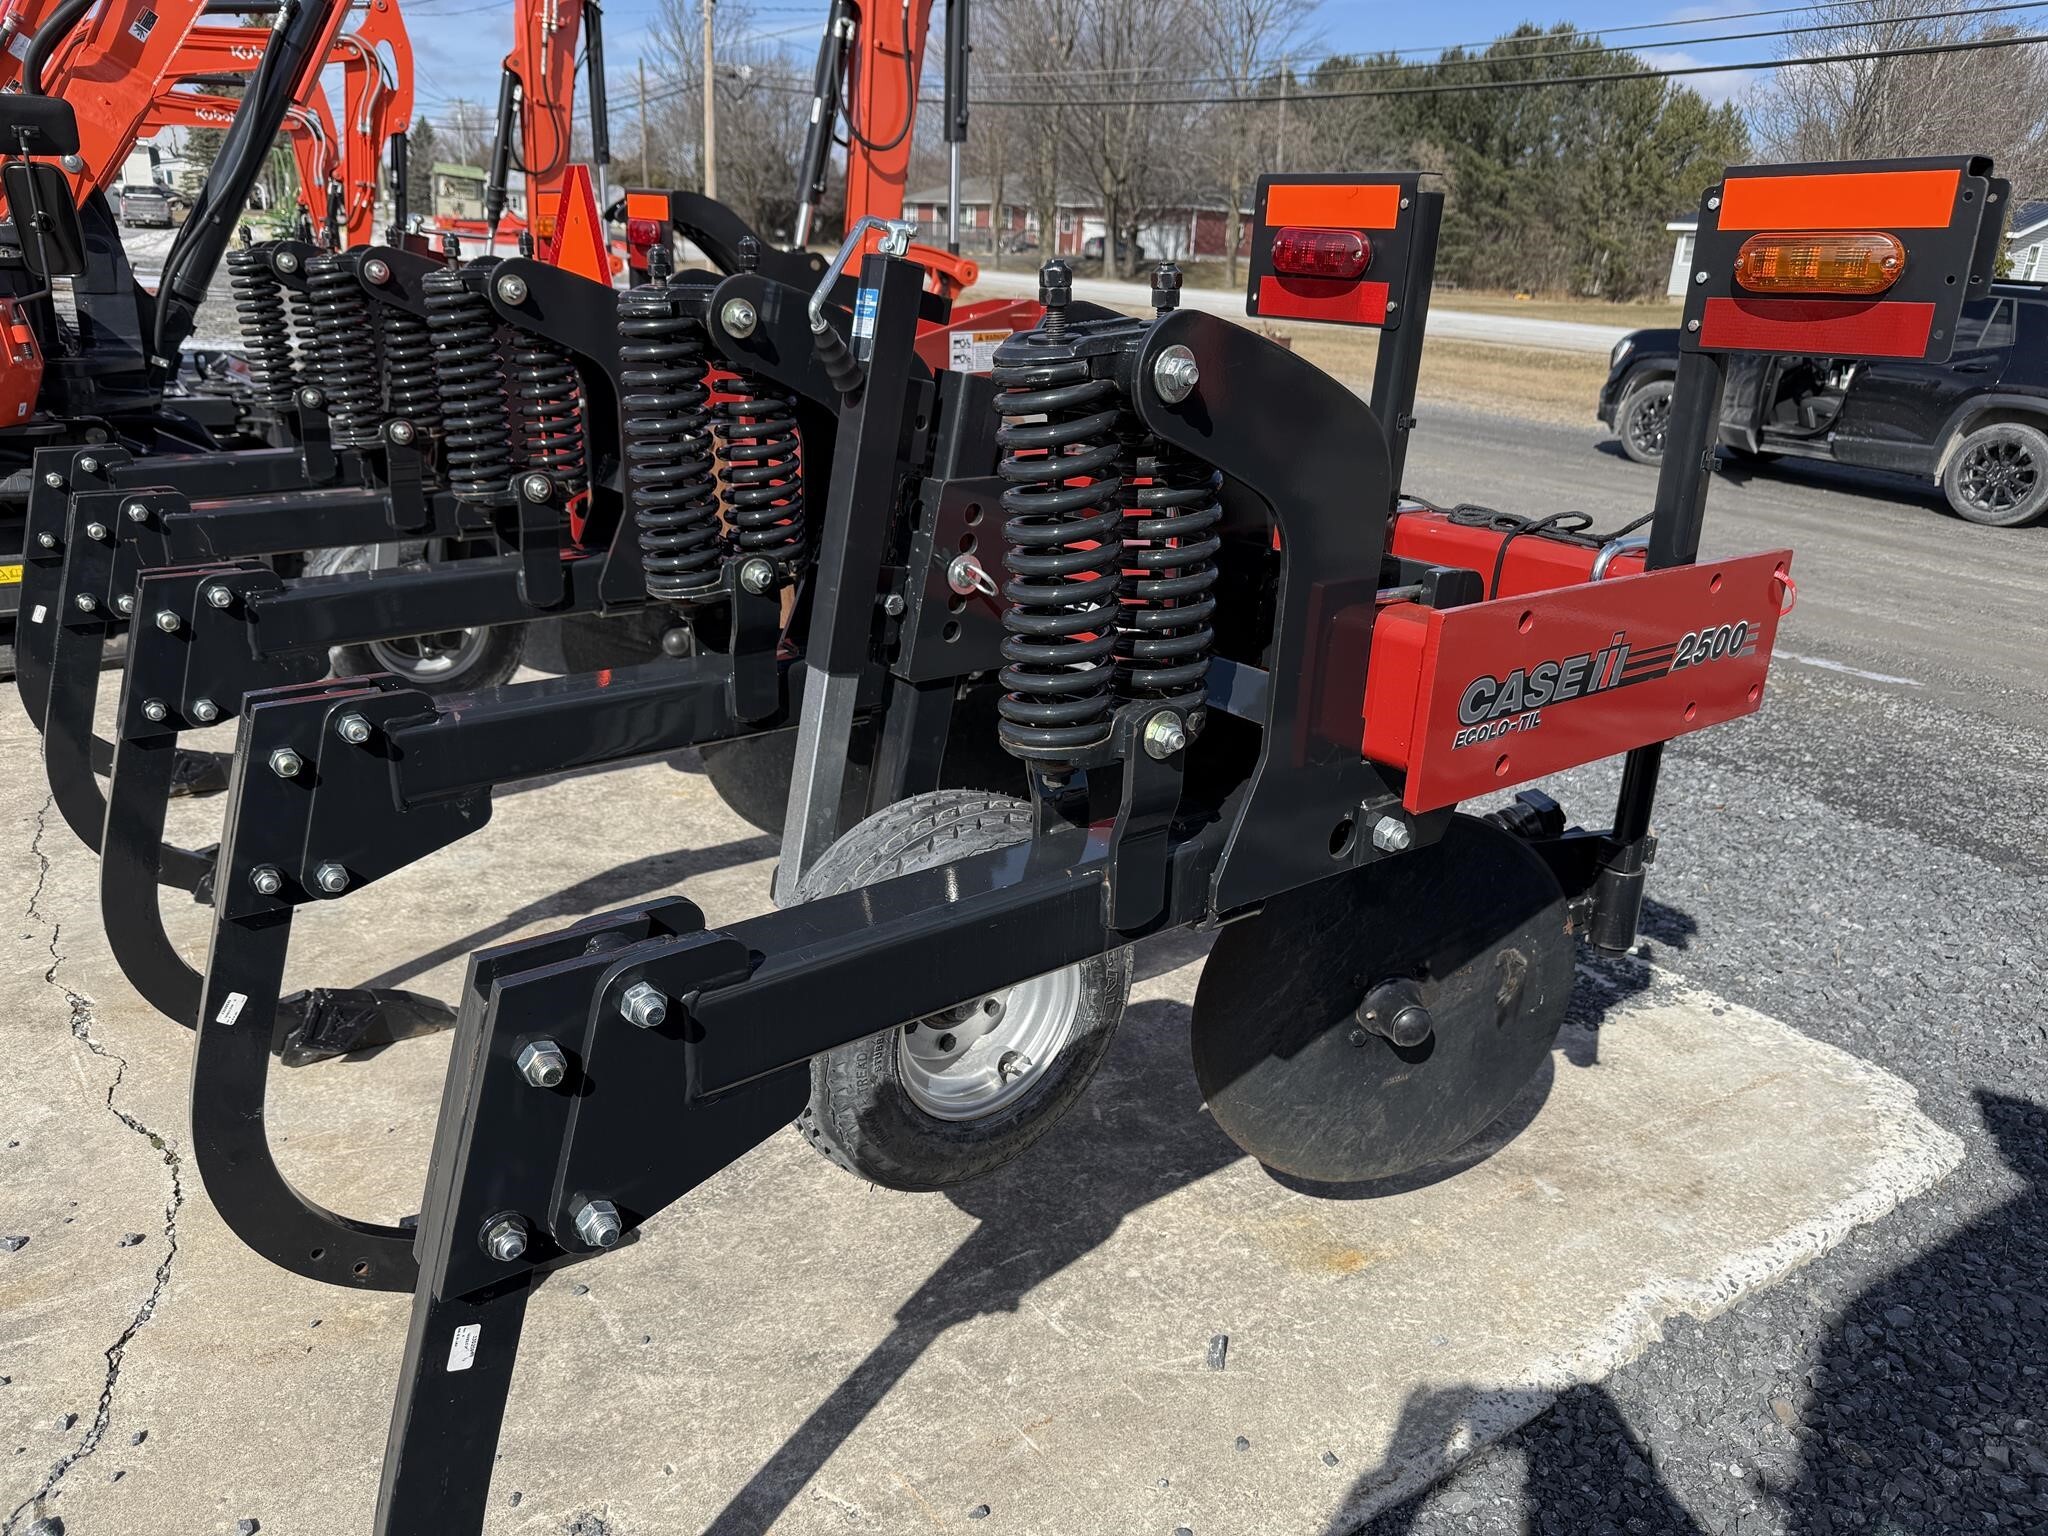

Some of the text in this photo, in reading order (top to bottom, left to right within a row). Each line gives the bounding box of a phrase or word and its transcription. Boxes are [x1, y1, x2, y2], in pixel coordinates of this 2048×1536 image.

[230, 45, 264, 60] Kub
[195, 107, 237, 123] Kubot
[1459, 654, 1590, 725] CASE
[1670, 619, 1749, 672] 2500
[1451, 710, 1541, 751] ECOLO-TIL
[856, 1052, 868, 1095] TREAD
